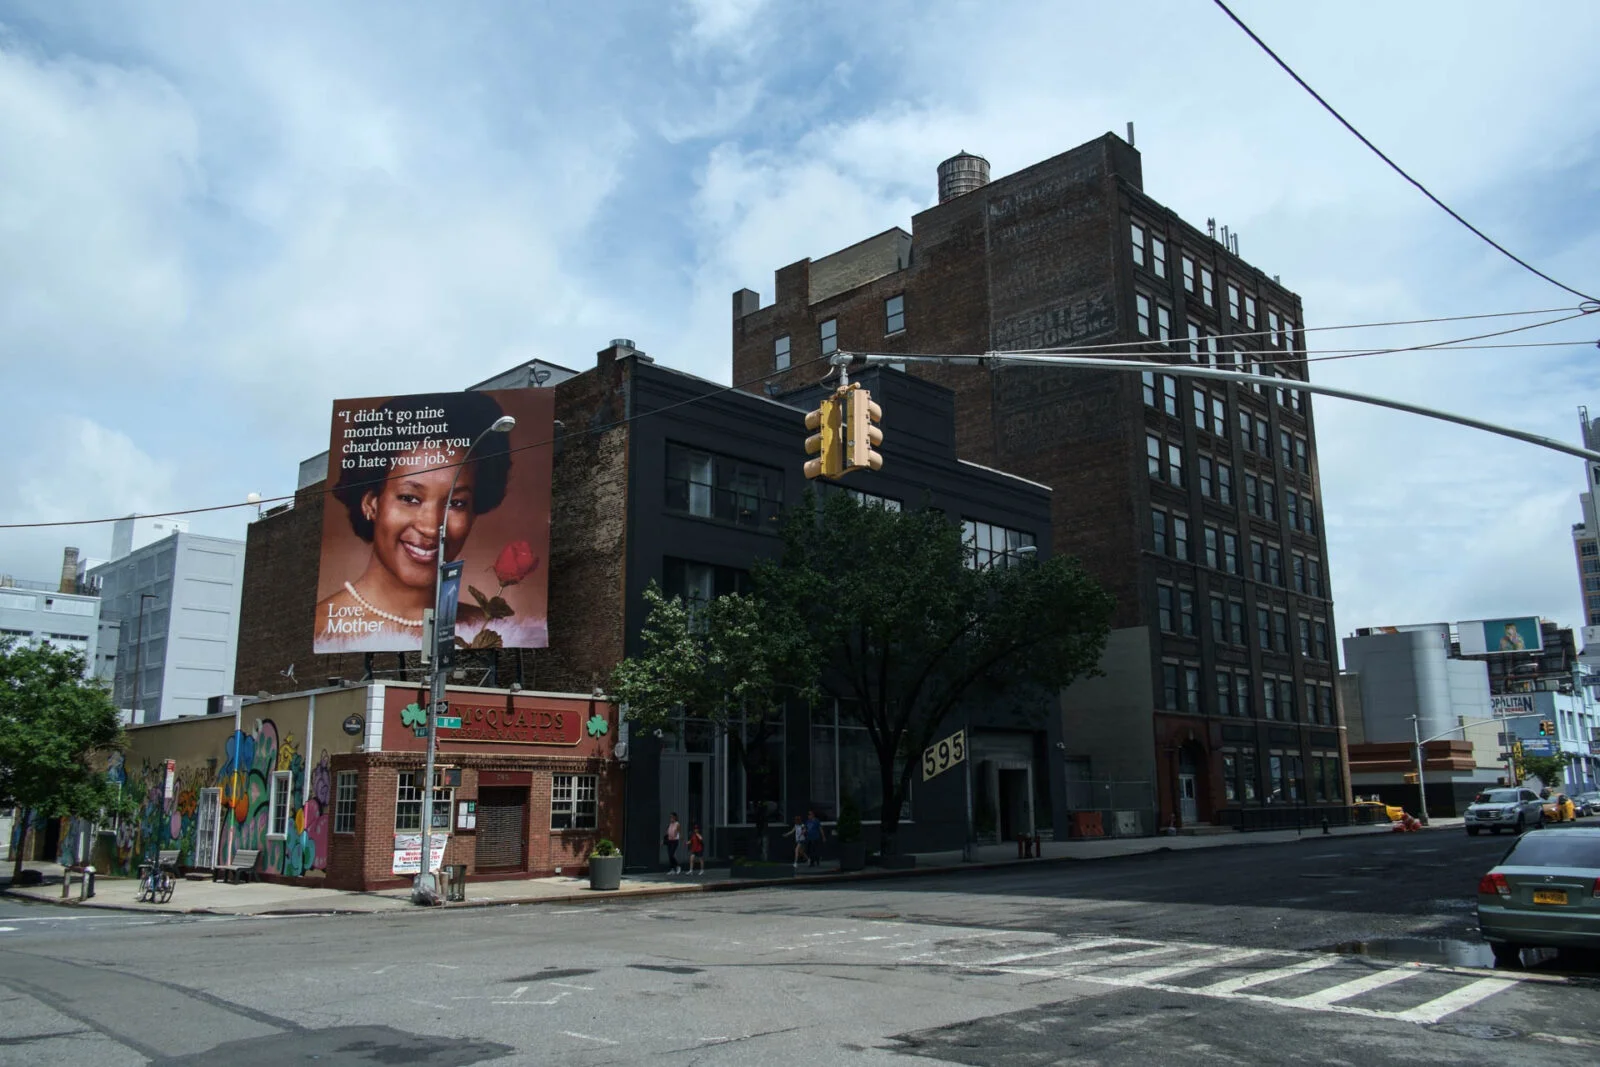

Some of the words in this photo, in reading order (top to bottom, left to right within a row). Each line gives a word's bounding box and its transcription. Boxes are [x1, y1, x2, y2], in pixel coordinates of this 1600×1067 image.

[396, 411, 412, 424] go
[415, 407, 445, 419] nine
[344, 424, 393, 438] months
[397, 421, 449, 436] without
[342, 438, 419, 454] chardonnay
[422, 437, 444, 449] for
[446, 438, 470, 452] you
[341, 458, 355, 469] to
[358, 454, 387, 468] hate
[390, 454, 421, 471] your
[328, 603, 365, 619] Love,
[327, 618, 384, 634] Mother
[450, 727, 529, 742] RESTAURANT
[925, 733, 963, 776] 595
